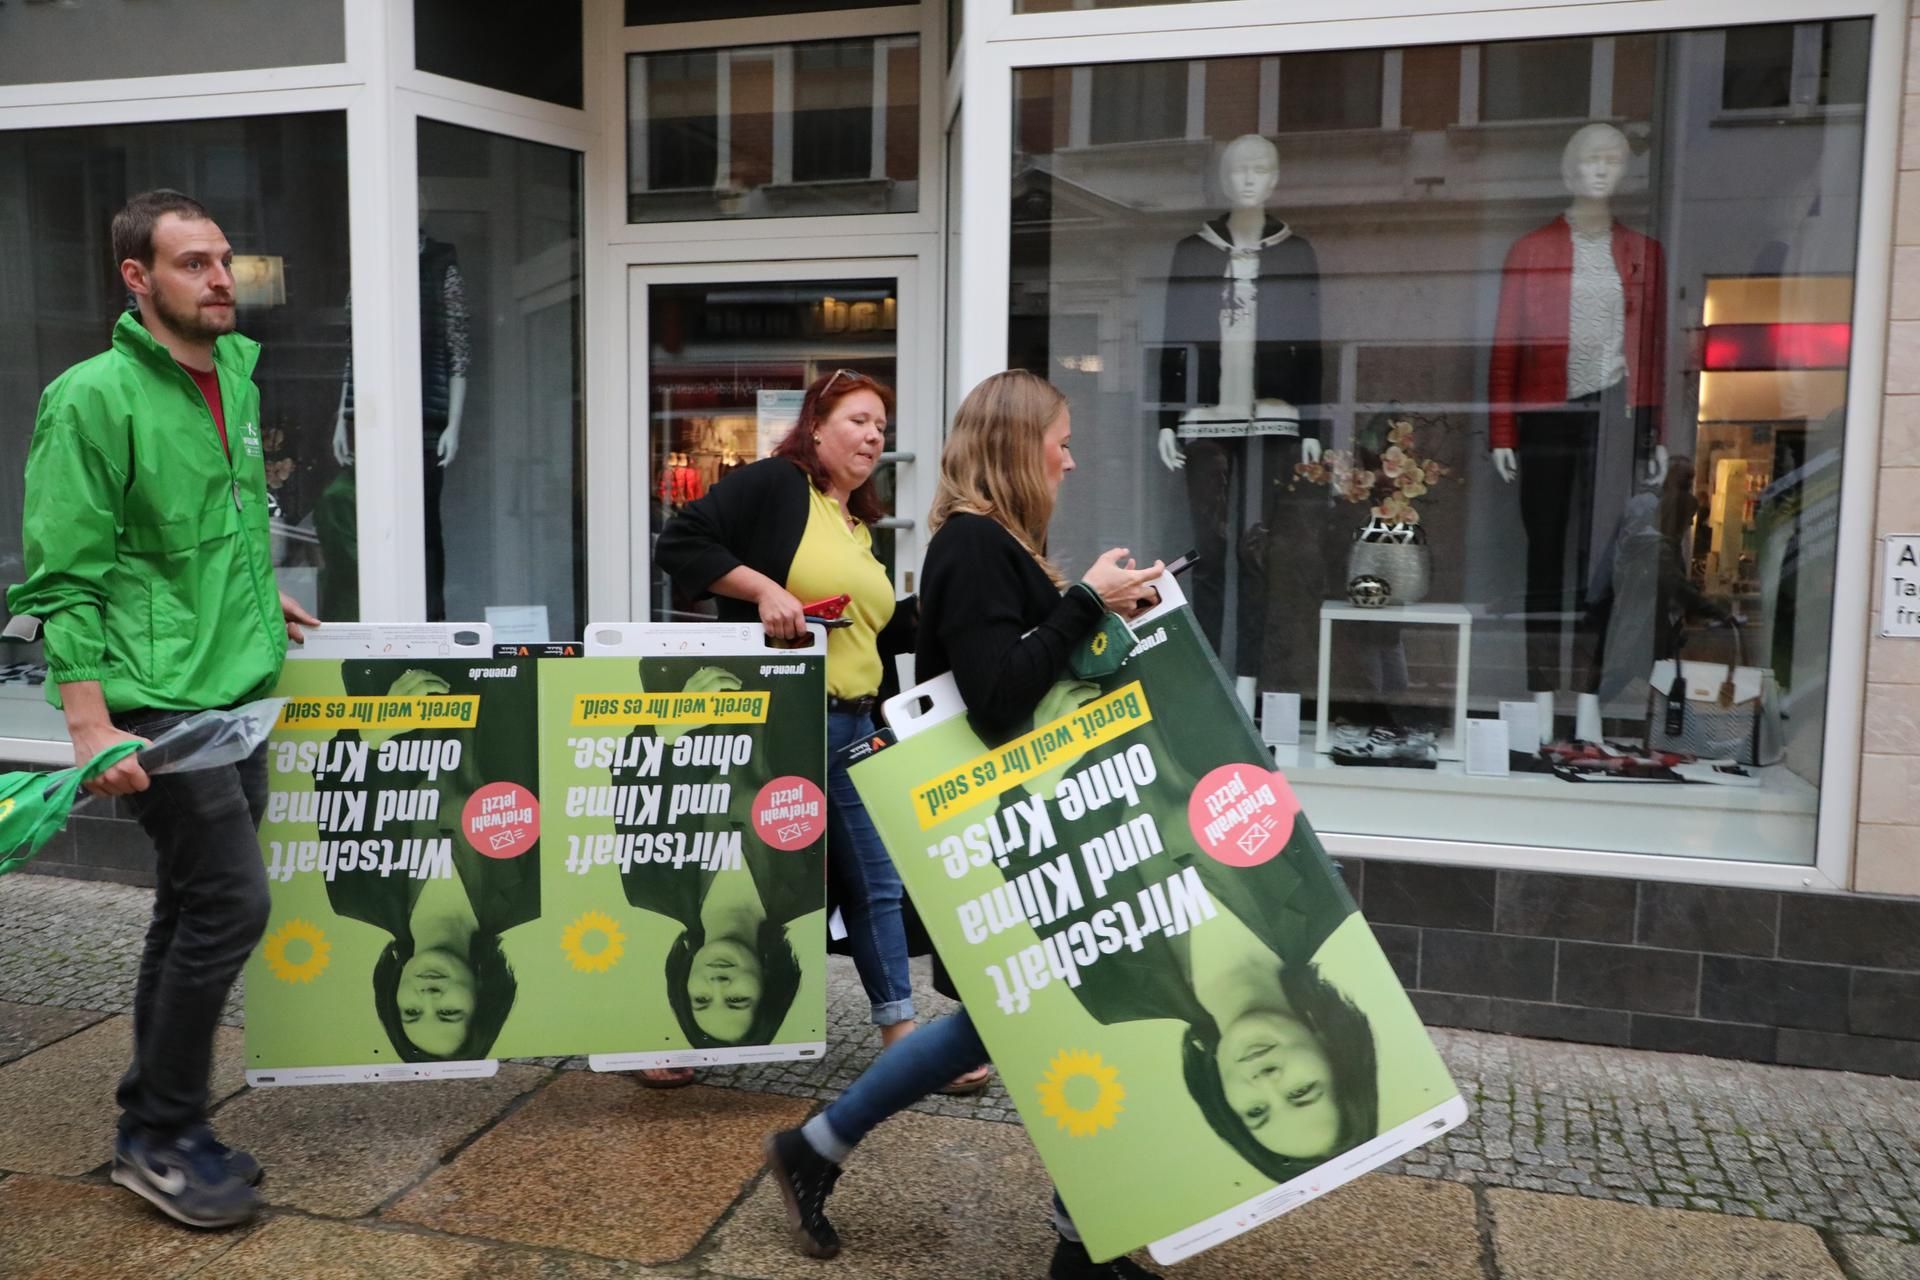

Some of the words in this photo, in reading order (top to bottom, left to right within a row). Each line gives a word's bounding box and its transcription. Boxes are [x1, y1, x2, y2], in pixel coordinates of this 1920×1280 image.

[1892, 577, 1920, 597] Ta
[468, 666, 518, 680] gruene.de
[759, 663, 806, 677] gruene.de
[283, 703, 321, 723] seid.
[326, 703, 345, 718] es
[350, 703, 373, 722] Ihr
[378, 703, 411, 721] weil
[417, 702, 472, 721] Bereit,
[580, 699, 618, 719] seid.
[624, 700, 641, 713] es
[647, 700, 668, 718] Ihr
[673, 699, 704, 717] weil
[710, 698, 762, 717] Bereit,
[1073, 692, 1141, 738] Bereit,
[270, 740, 369, 782] Krise.
[378, 740, 462, 781] ohne
[567, 736, 665, 777] Krise.
[672, 735, 752, 775] ohne
[1003, 746, 1030, 772] Ihr
[1031, 726, 1072, 764] weil
[973, 762, 996, 786] es
[1058, 744, 1157, 820] ohne
[268, 790, 366, 832] Klima
[374, 789, 439, 831] und
[482, 790, 516, 815] jetzt!
[565, 784, 663, 825] Klima
[668, 783, 731, 825] und
[760, 801, 818, 826] Briefwahl
[771, 784, 803, 808] jetzt!
[921, 775, 968, 816] seid.
[1204, 772, 1248, 817] jetzt!
[471, 806, 533, 834] Briefwahl
[1204, 784, 1276, 846] Briefwahl
[565, 831, 742, 875] Wirtschaft
[927, 791, 1057, 879] Krise.
[267, 839, 452, 882] Wirtschaft
[1080, 814, 1163, 898] und
[957, 854, 1083, 944] Klima
[986, 866, 1220, 1014] Wirtschaft
